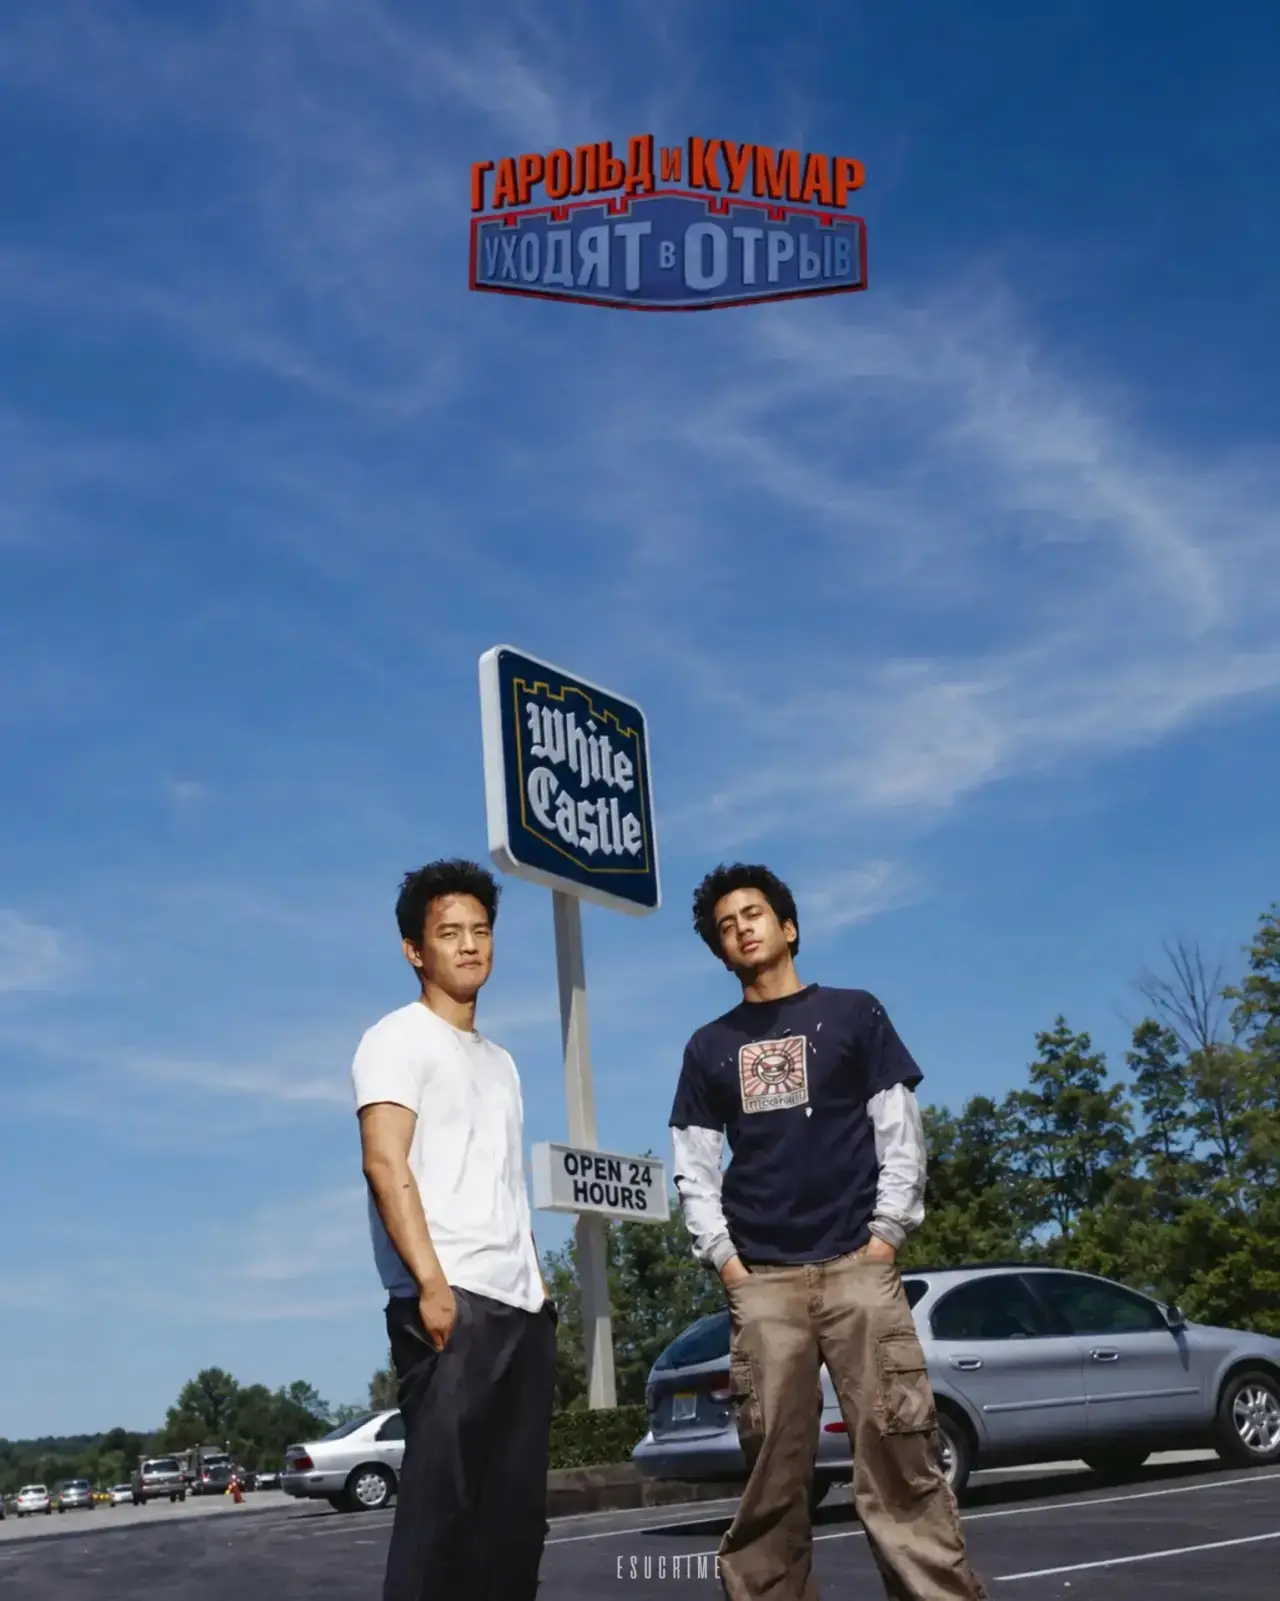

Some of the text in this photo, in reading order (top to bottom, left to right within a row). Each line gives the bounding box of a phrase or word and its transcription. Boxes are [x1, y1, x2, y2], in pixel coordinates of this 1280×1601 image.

[526, 702, 634, 793] White
[527, 766, 642, 856] Castle
[564, 1153, 652, 1188] OPEN 24
[573, 1180, 647, 1210] HOURS
